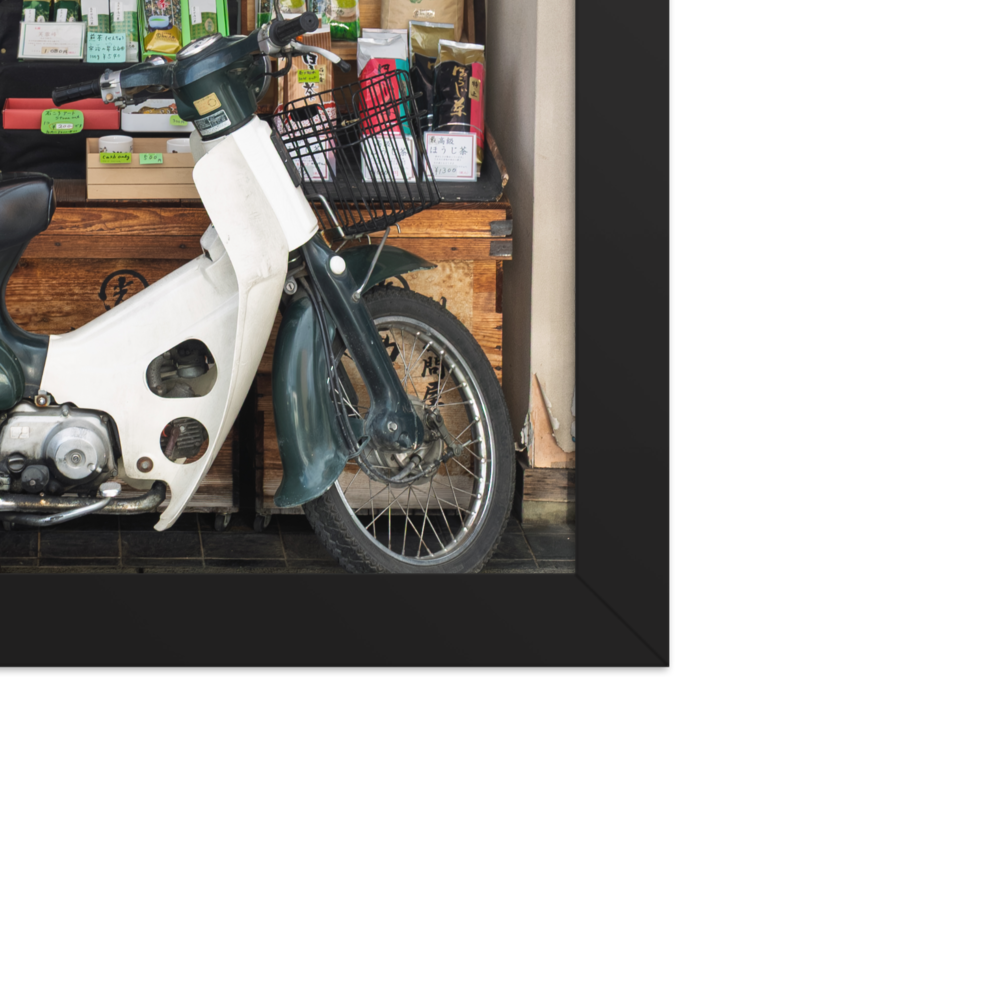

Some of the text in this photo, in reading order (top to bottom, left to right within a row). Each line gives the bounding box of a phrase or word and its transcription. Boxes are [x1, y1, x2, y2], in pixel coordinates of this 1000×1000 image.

[450, 65, 468, 117] ほうじ茶
[430, 146, 468, 155] ほうじ茶
